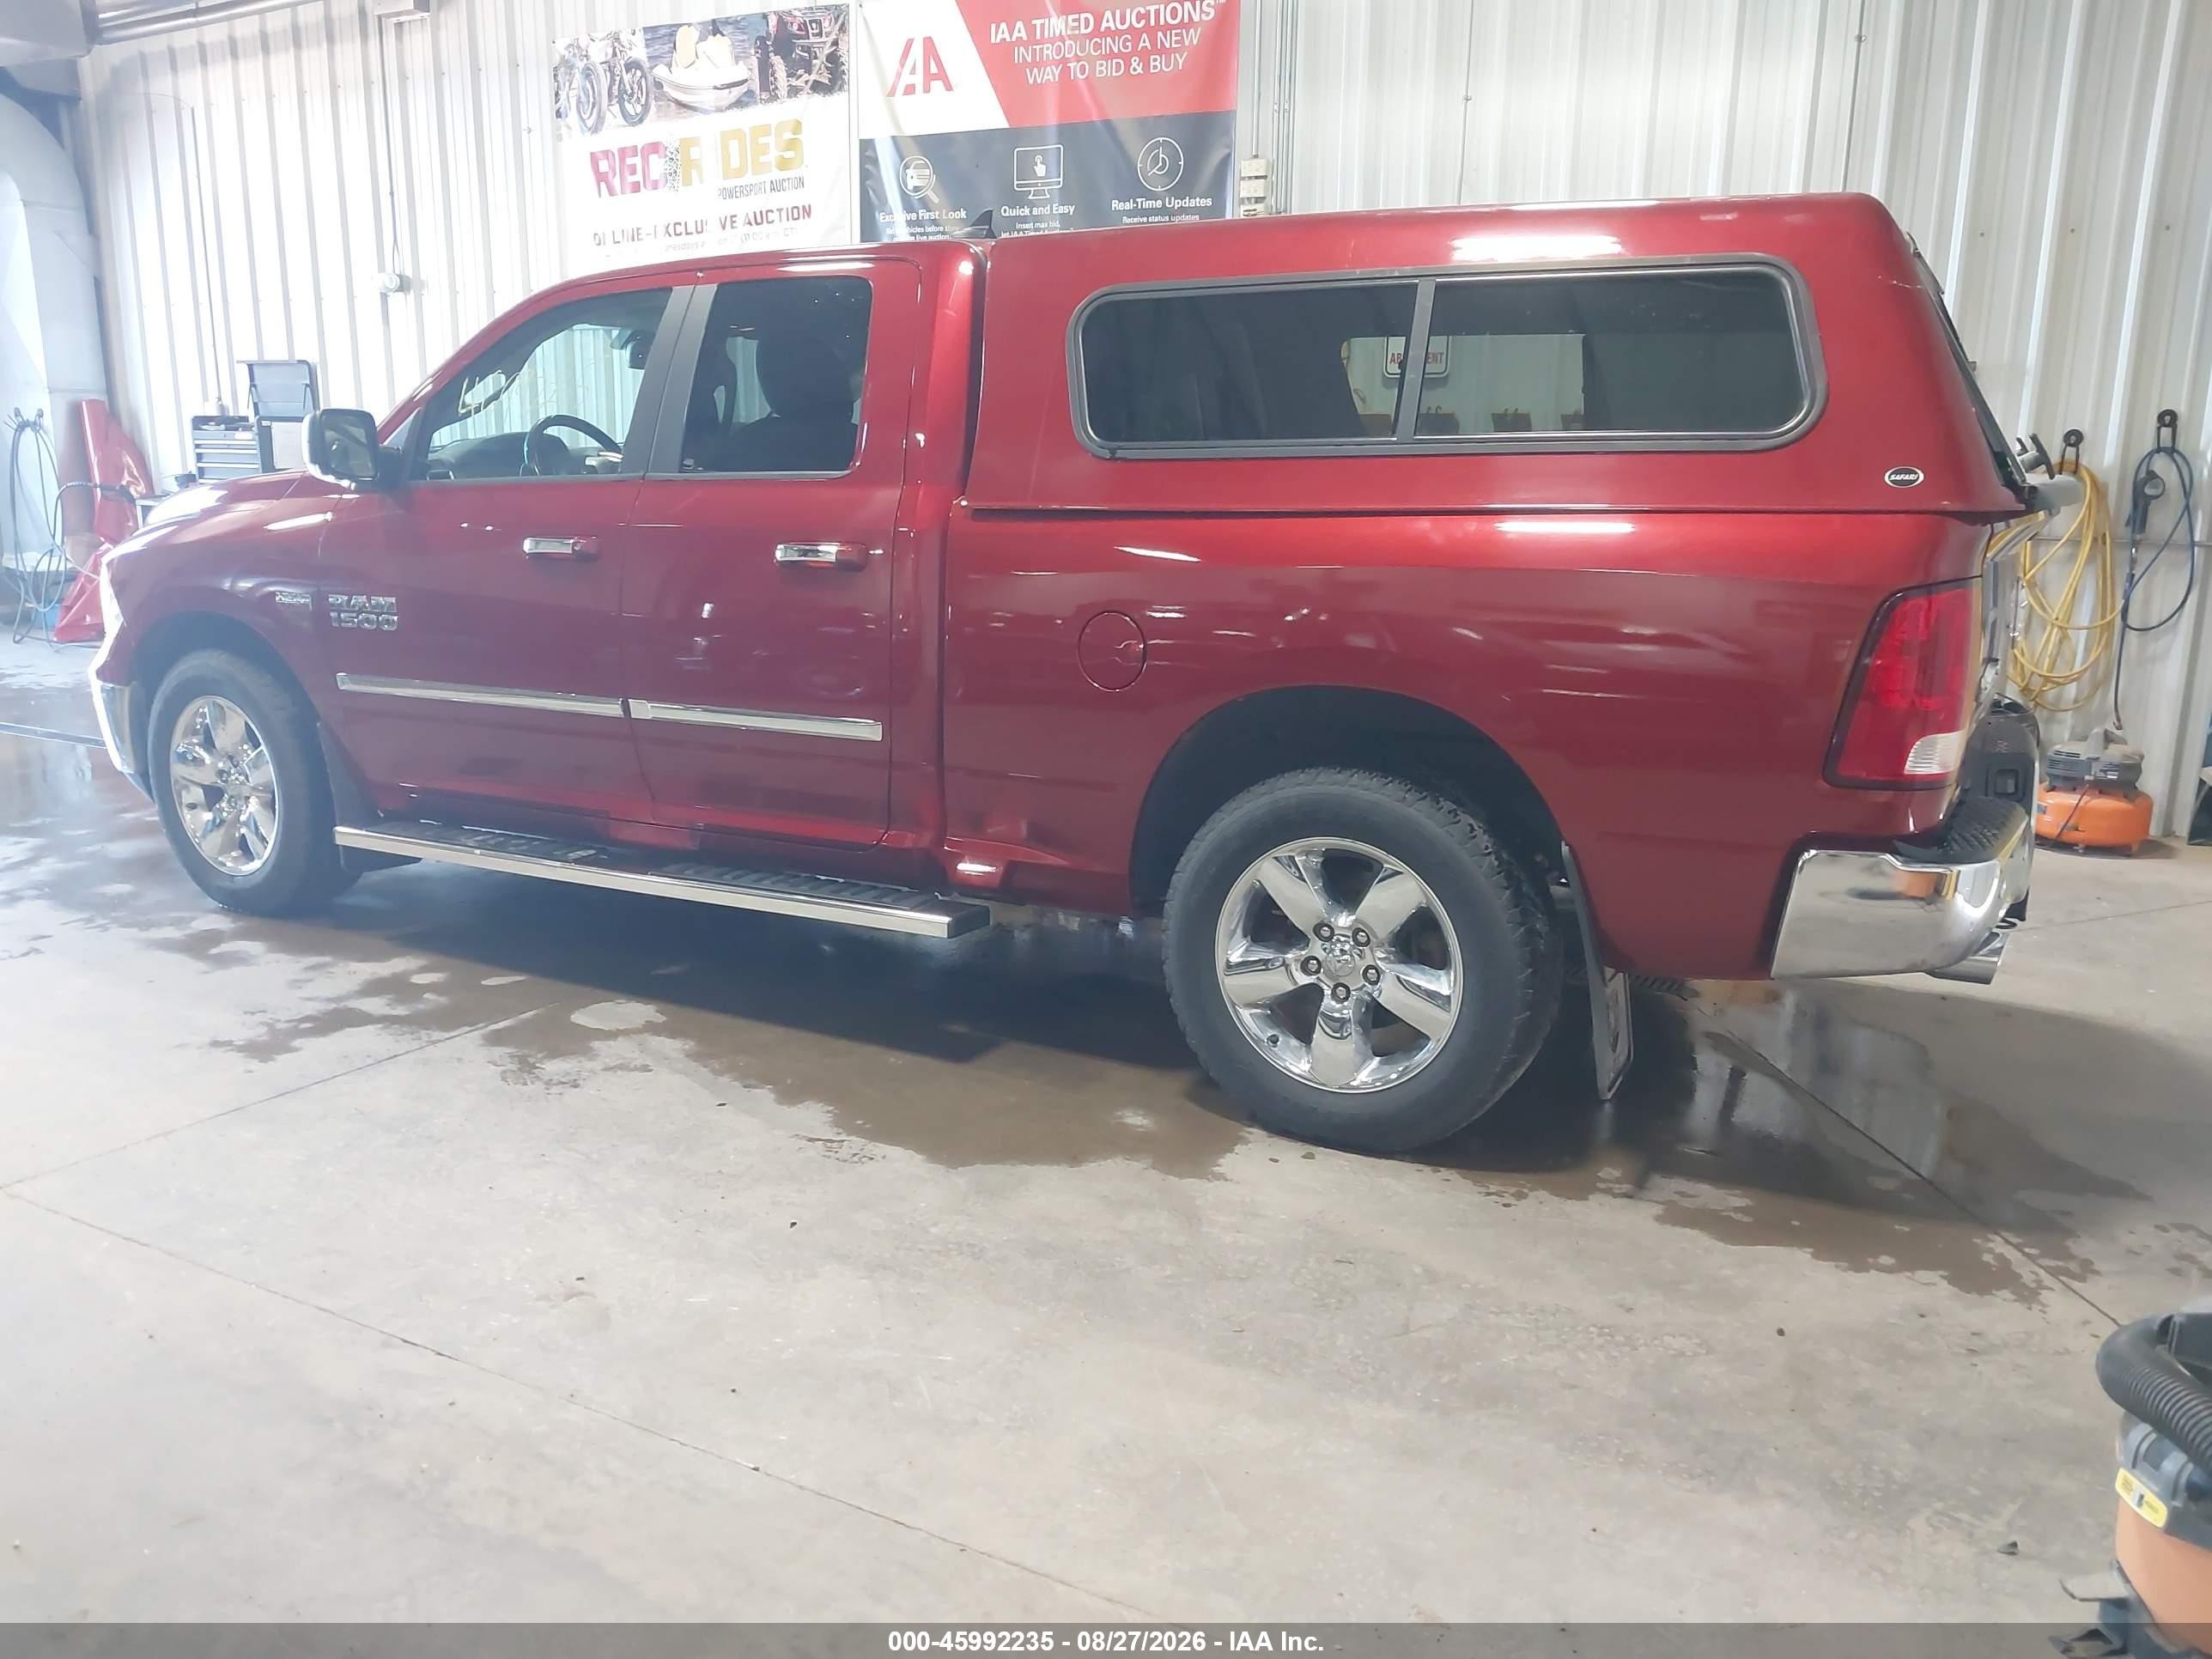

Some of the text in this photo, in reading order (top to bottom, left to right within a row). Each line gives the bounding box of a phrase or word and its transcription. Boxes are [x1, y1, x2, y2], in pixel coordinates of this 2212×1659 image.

[989, 21, 1028, 44] IAA
[1030, 12, 1095, 40] TIMED
[1014, 27, 1201, 64] INTRODUCING A NEW
[1025, 51, 1188, 85] WAY TO BID & BUY
[679, 118, 805, 187] RDES
[769, 176, 805, 193] AUCTION
[1000, 204, 1075, 217] Quick and Easy
[1111, 197, 1212, 211] Real-Time Updates
[743, 204, 812, 229] AUCTION
[879, 208, 967, 222] Excive First Look
[1170, 213, 1200, 222] updates
[328, 593, 398, 613] RAM
[329, 611, 399, 631] 1500
